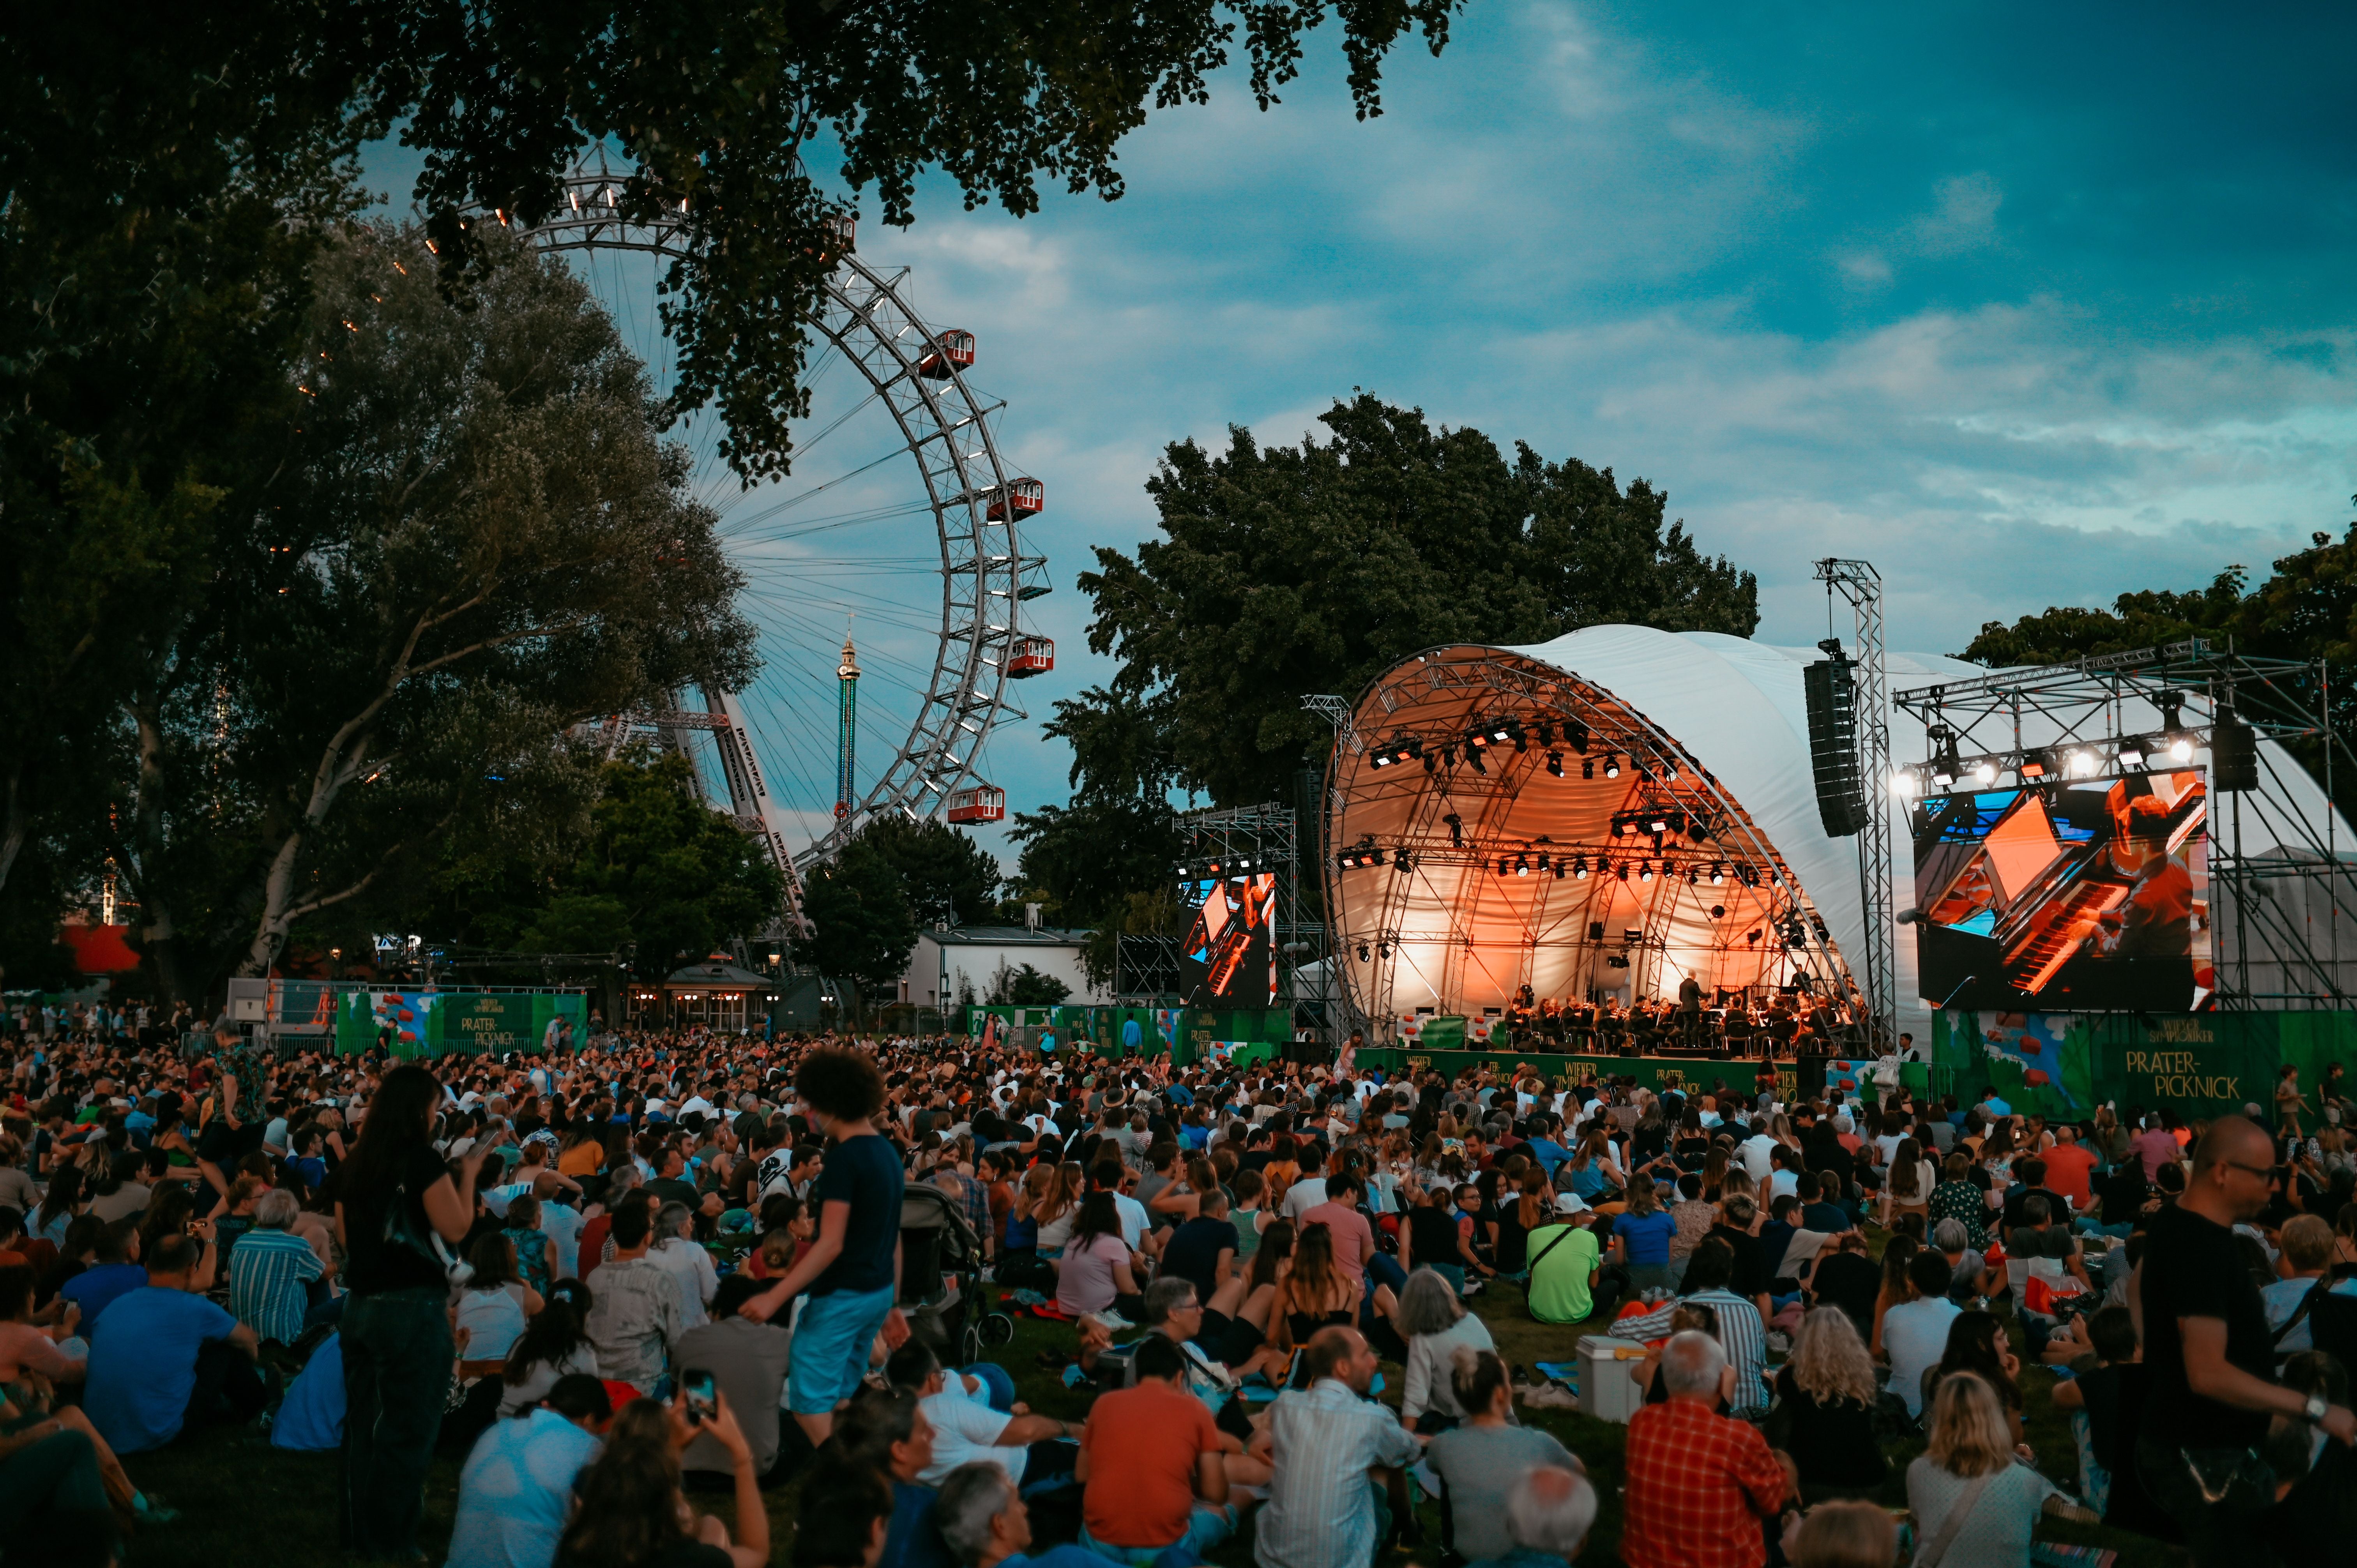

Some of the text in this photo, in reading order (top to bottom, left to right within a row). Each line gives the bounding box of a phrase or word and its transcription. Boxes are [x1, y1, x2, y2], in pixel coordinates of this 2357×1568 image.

[462, 1018, 498, 1031] PRATER-
[475, 1032, 514, 1045] PICKNICK
[1191, 1030, 1212, 1041] PRATER-
[1478, 1061, 1500, 1072] PTER-
[2127, 1052, 2201, 1073] PRATER-
[1565, 1062, 1596, 1077] WIENER
[1657, 1069, 1686, 1081] PRATER-
[1492, 1073, 1512, 1084] KNICK
[1678, 1083, 1700, 1095] KNICK
[2155, 1075, 2240, 1099] PICKNICK
